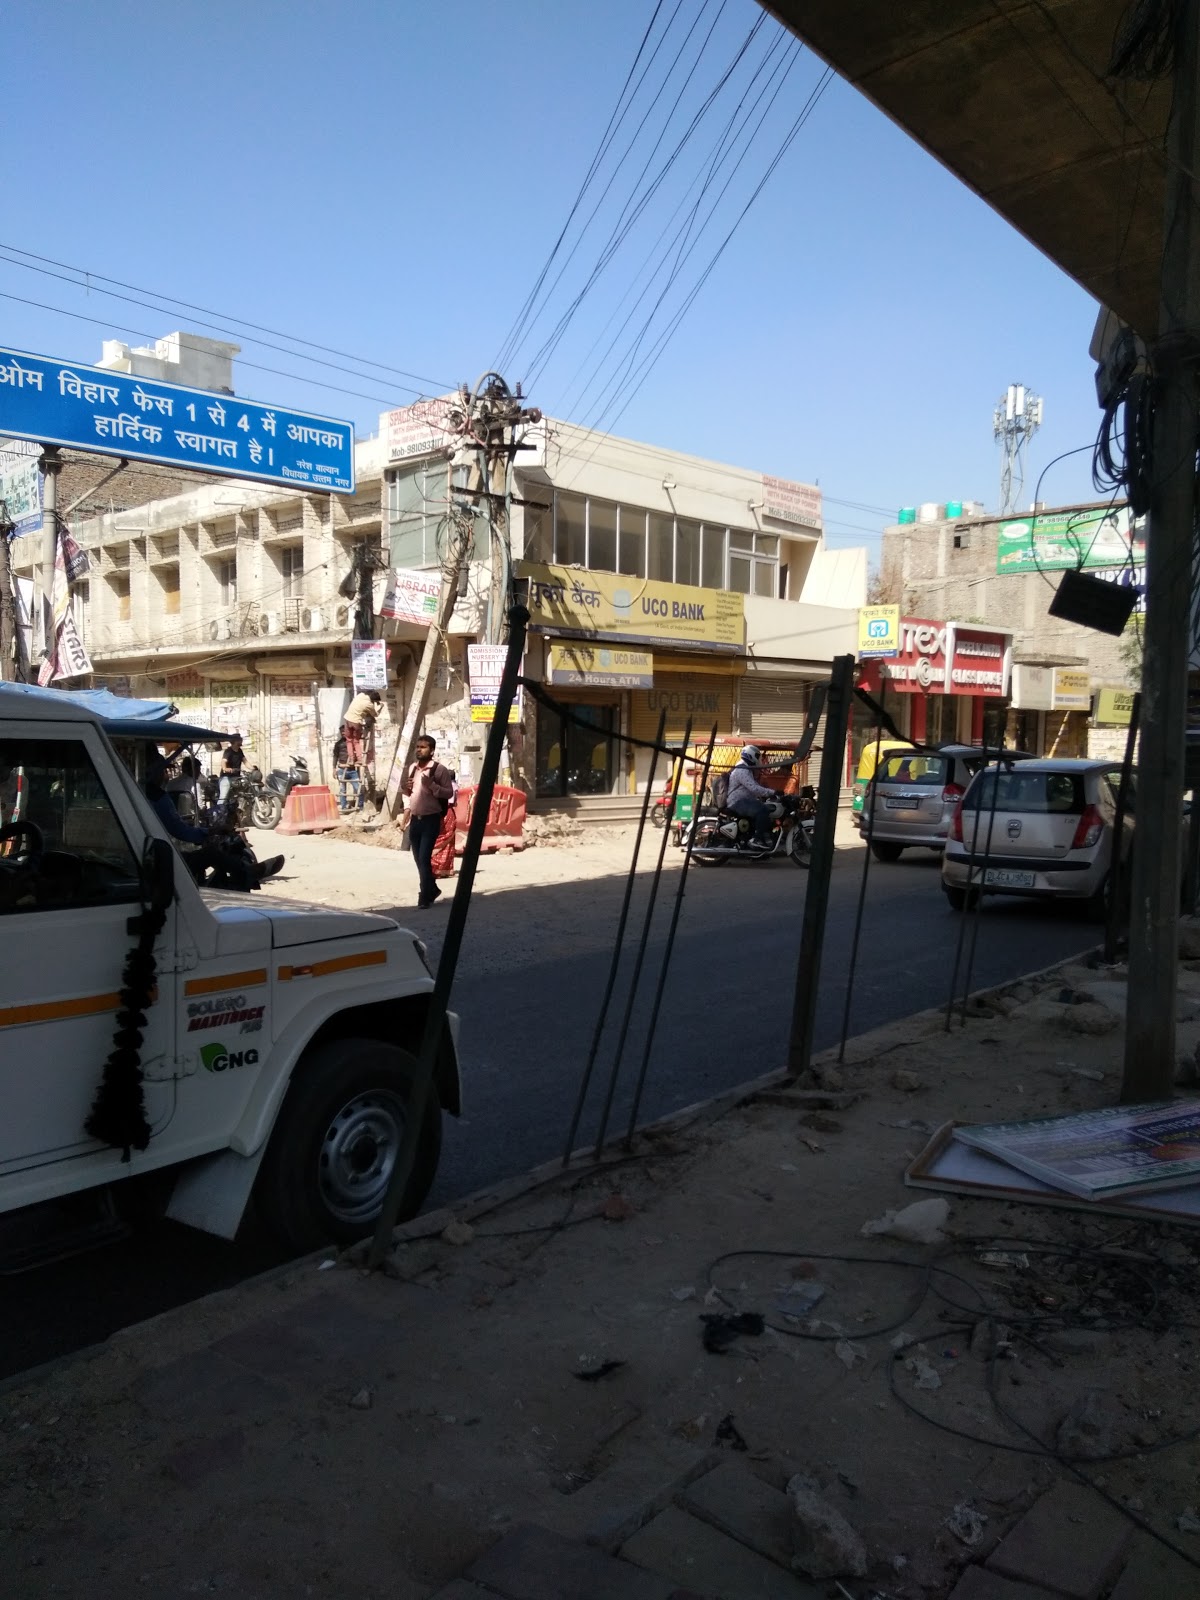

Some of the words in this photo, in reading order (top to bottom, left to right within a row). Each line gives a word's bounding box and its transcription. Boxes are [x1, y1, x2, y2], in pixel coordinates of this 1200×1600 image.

[0, 359, 43, 391] ओम
[57, 370, 120, 406] विहार
[131, 385, 173, 416] फेस
[186, 404, 196, 421] 1
[207, 401, 226, 428] से
[237, 414, 250, 431] 4
[260, 412, 277, 437] में
[287, 423, 344, 450] आपका
[93, 413, 162, 444] हार्दिक
[174, 430, 237, 458] स्वागत
[296, 458, 313, 470] नरेश
[312, 473, 332, 484] उत्तम
[335, 477, 350, 487] नगर
[395, 579, 441, 597] LIBRARY
[570, 580, 601, 608] बैंक
[642, 596, 668, 617] UCO
[672, 601, 705, 621] BANK
[64, 618, 89, 670] STARS
[614, 653, 628, 664] UCO
[630, 655, 648, 666] BANK
[568, 673, 582, 682] 24
[585, 674, 616, 684] Hours
[619, 676, 641, 685] ATM
[648, 689, 679, 711] UCO
[686, 691, 721, 713] BANK
[187, 994, 247, 1018] BOLERO
[213, 1049, 259, 1072] CNG
